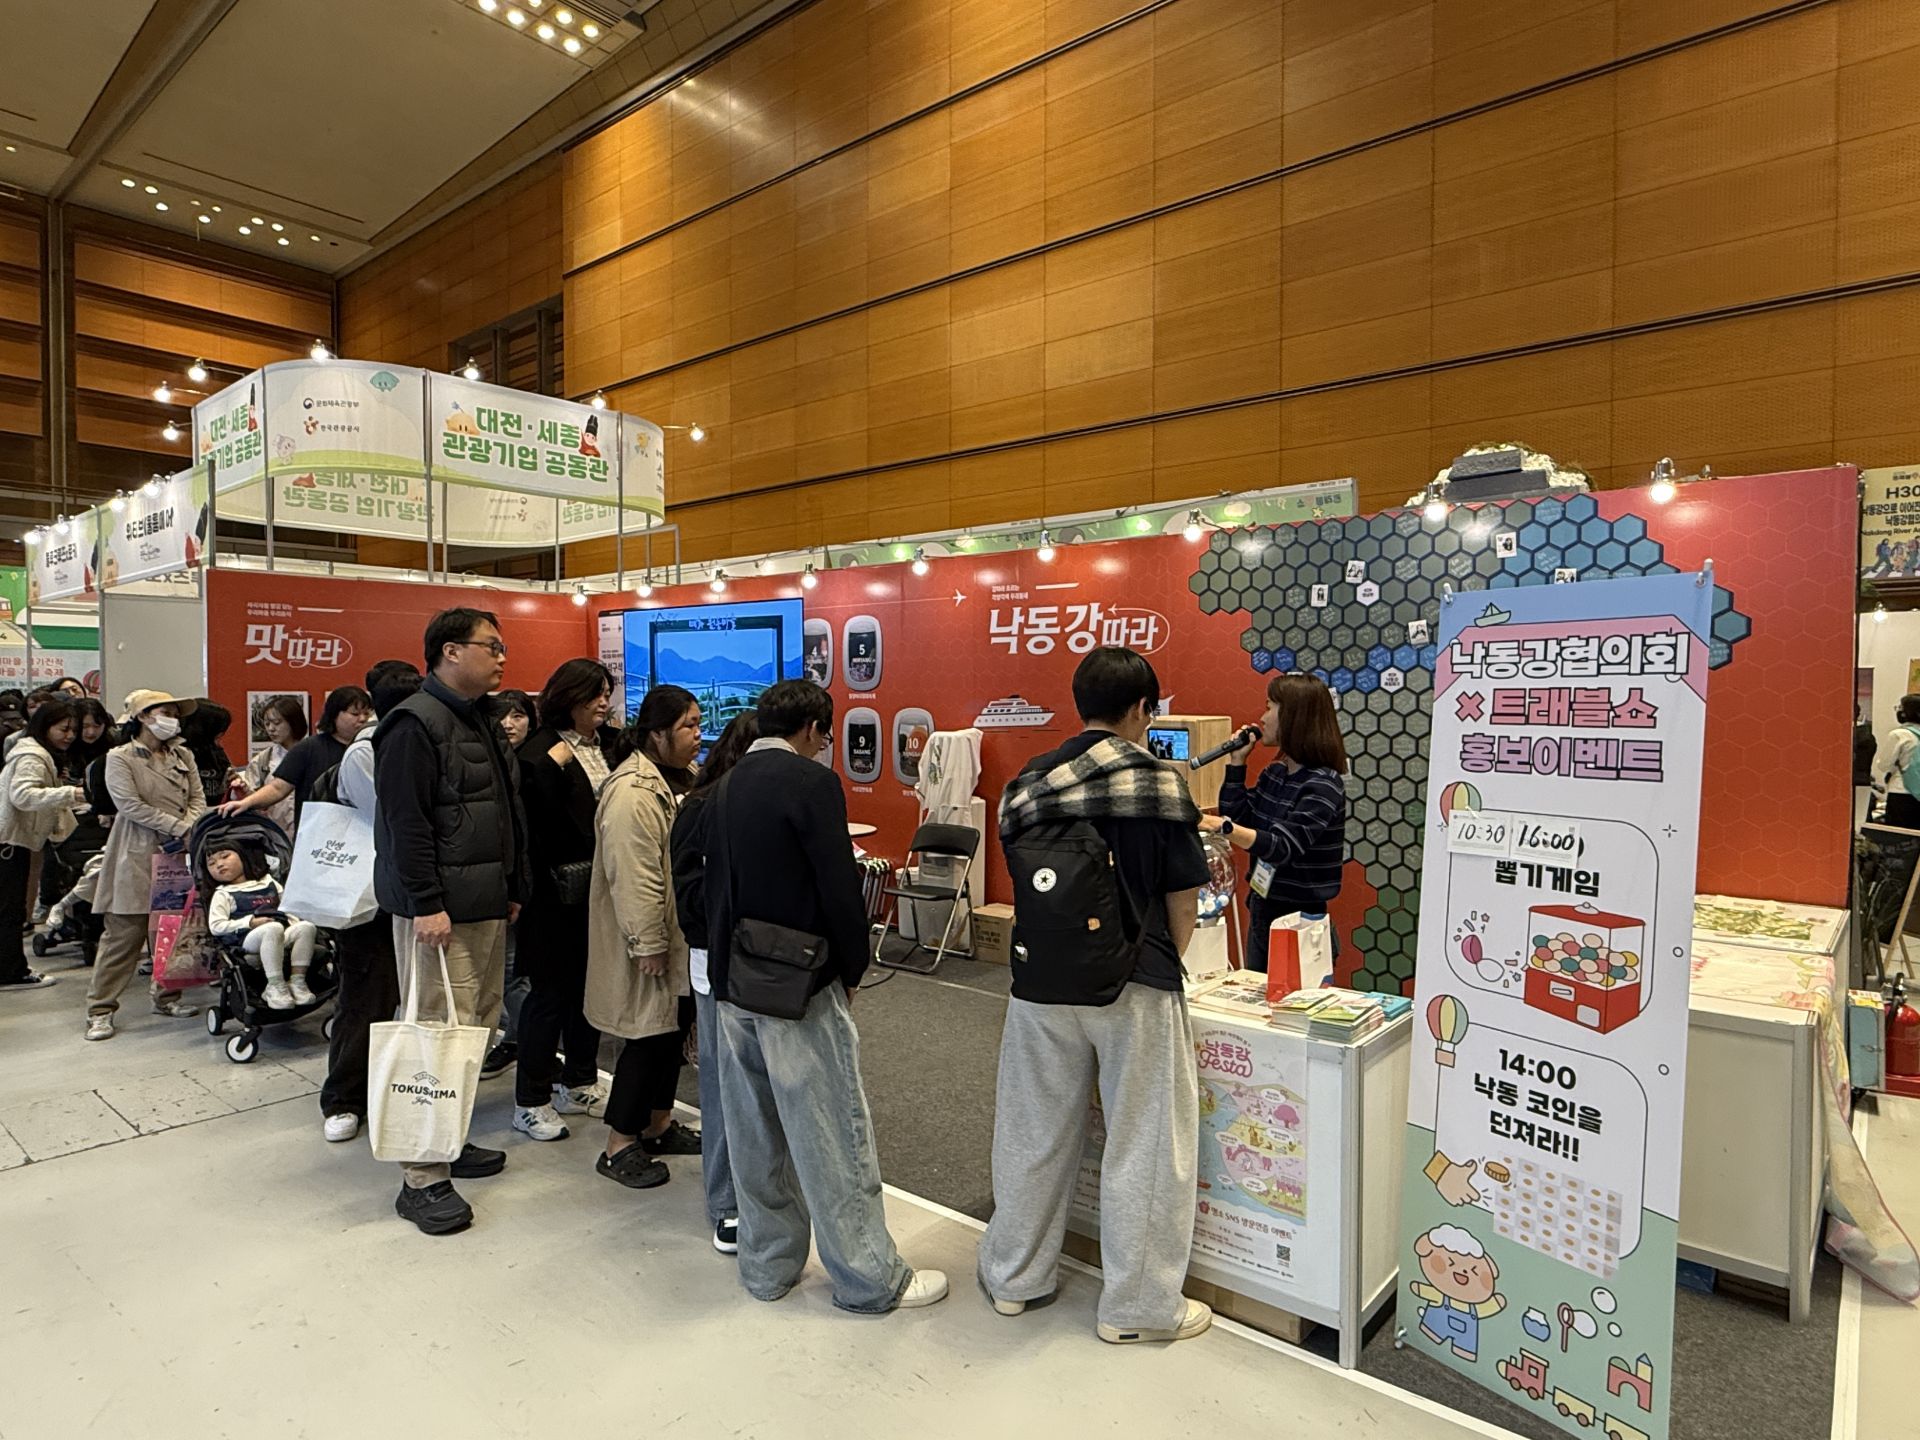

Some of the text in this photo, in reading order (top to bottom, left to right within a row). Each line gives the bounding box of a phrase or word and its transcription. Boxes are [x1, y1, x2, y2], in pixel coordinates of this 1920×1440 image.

[476, 406, 581, 449] 대전·세종
[235, 430, 262, 464] 공동관
[442, 431, 538, 472] 관광기업
[545, 450, 609, 483] 공동관
[859, 644, 866, 655] 5
[1450, 632, 1690, 679] 낙동강협의회
[1490, 687, 1659, 728] 트래블쇼
[859, 736, 866, 747] 9
[909, 738, 919, 749] 10
[1460, 733, 1663, 783] 홍보이벤트
[1457, 823, 1575, 851] 10:30 16:00
[1495, 860, 1600, 897] 뽑기게임
[1198, 1049, 1253, 1078] Festa
[1205, 1039, 1251, 1061] 낙동강
[1499, 1048, 1577, 1090] 14:00
[1474, 1072, 1603, 1135] 낙동 코인을
[1490, 1110, 1580, 1163] 던져라!!
[1225, 1212, 1240, 1224] SNS
[1271, 1226, 1293, 1241] 이벤트
